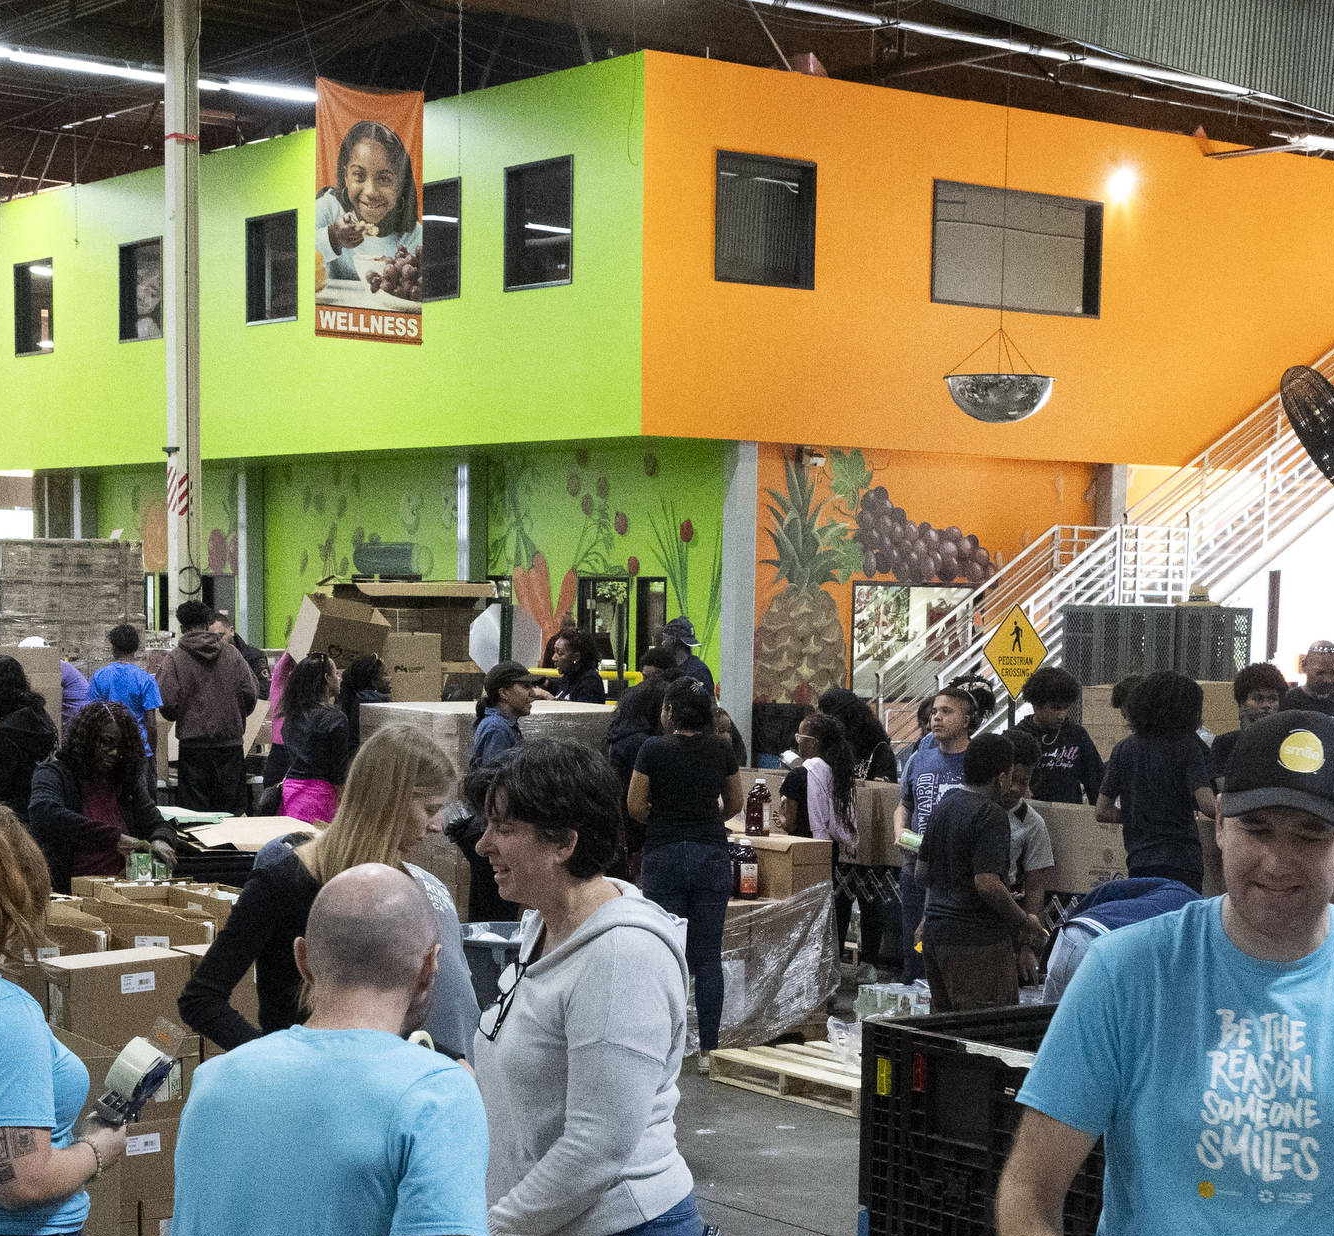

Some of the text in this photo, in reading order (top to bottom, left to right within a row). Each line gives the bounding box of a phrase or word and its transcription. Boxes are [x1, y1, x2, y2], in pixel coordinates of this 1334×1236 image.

[319, 310, 419, 337] WELLNESS
[998, 656, 1033, 666] PEDESTRIAN
[1001, 667, 1030, 677] CROSSING
[1216, 1008, 1307, 1062] BE THE
[1207, 1049, 1313, 1100] REASON
[1200, 1090, 1321, 1131] SOMEONE
[1196, 1124, 1320, 1182] SMILES
